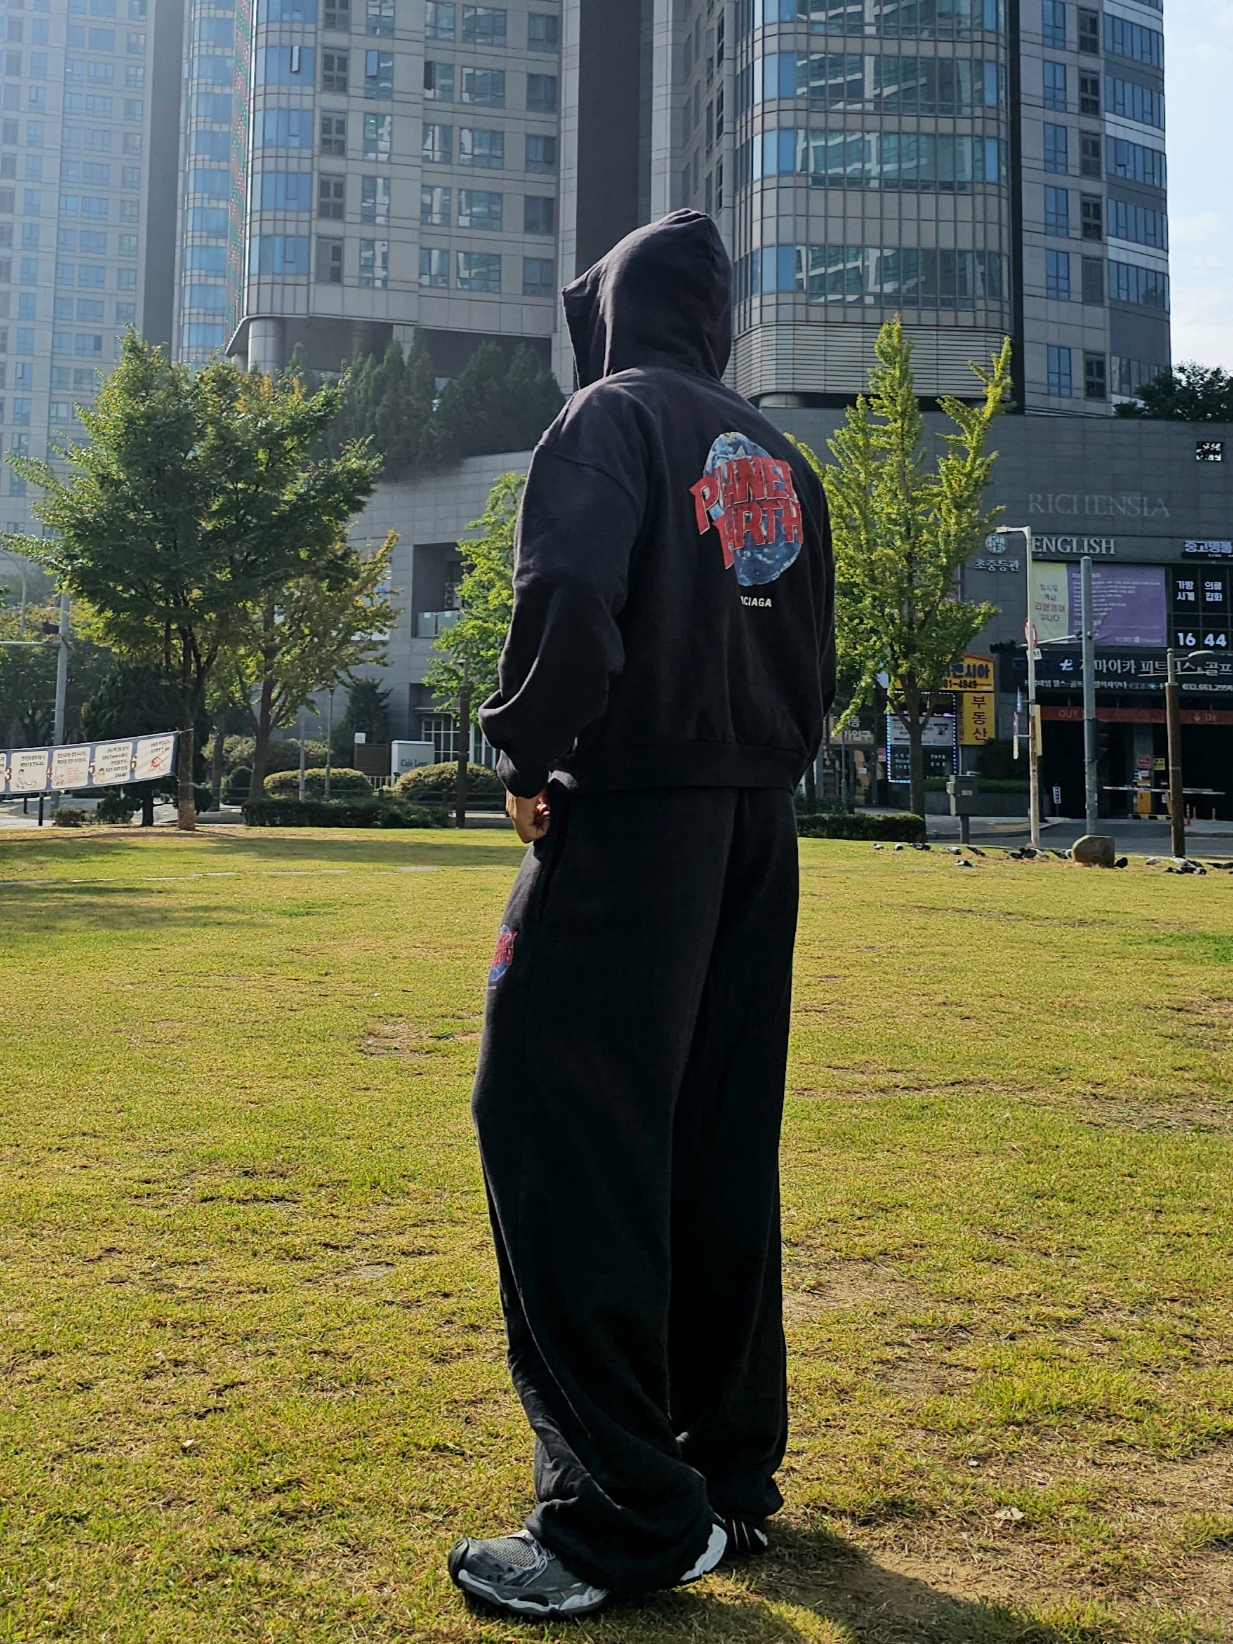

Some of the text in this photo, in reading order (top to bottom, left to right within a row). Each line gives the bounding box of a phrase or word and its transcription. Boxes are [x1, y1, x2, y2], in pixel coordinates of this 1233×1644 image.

[1028, 493, 1170, 518] RICHENSIA
[1031, 536, 1116, 555] ENGLISH
[1184, 540, 1232, 553] 중고명품
[975, 559, 1019, 572] 초중등관
[1176, 581, 1194, 590] 가방
[1204, 581, 1222, 590] 의류
[1176, 592, 1195, 601] 시계
[1177, 632, 1196, 646] 16
[1204, 633, 1227, 647] 44
[971, 695, 988, 741] 부동산
[1059, 709, 1079, 718] OUT
[1204, 713, 1216, 721] IN
[5, 767, 12, 782] 3
[46, 764, 53, 779] 4
[88, 760, 96, 775] 5
